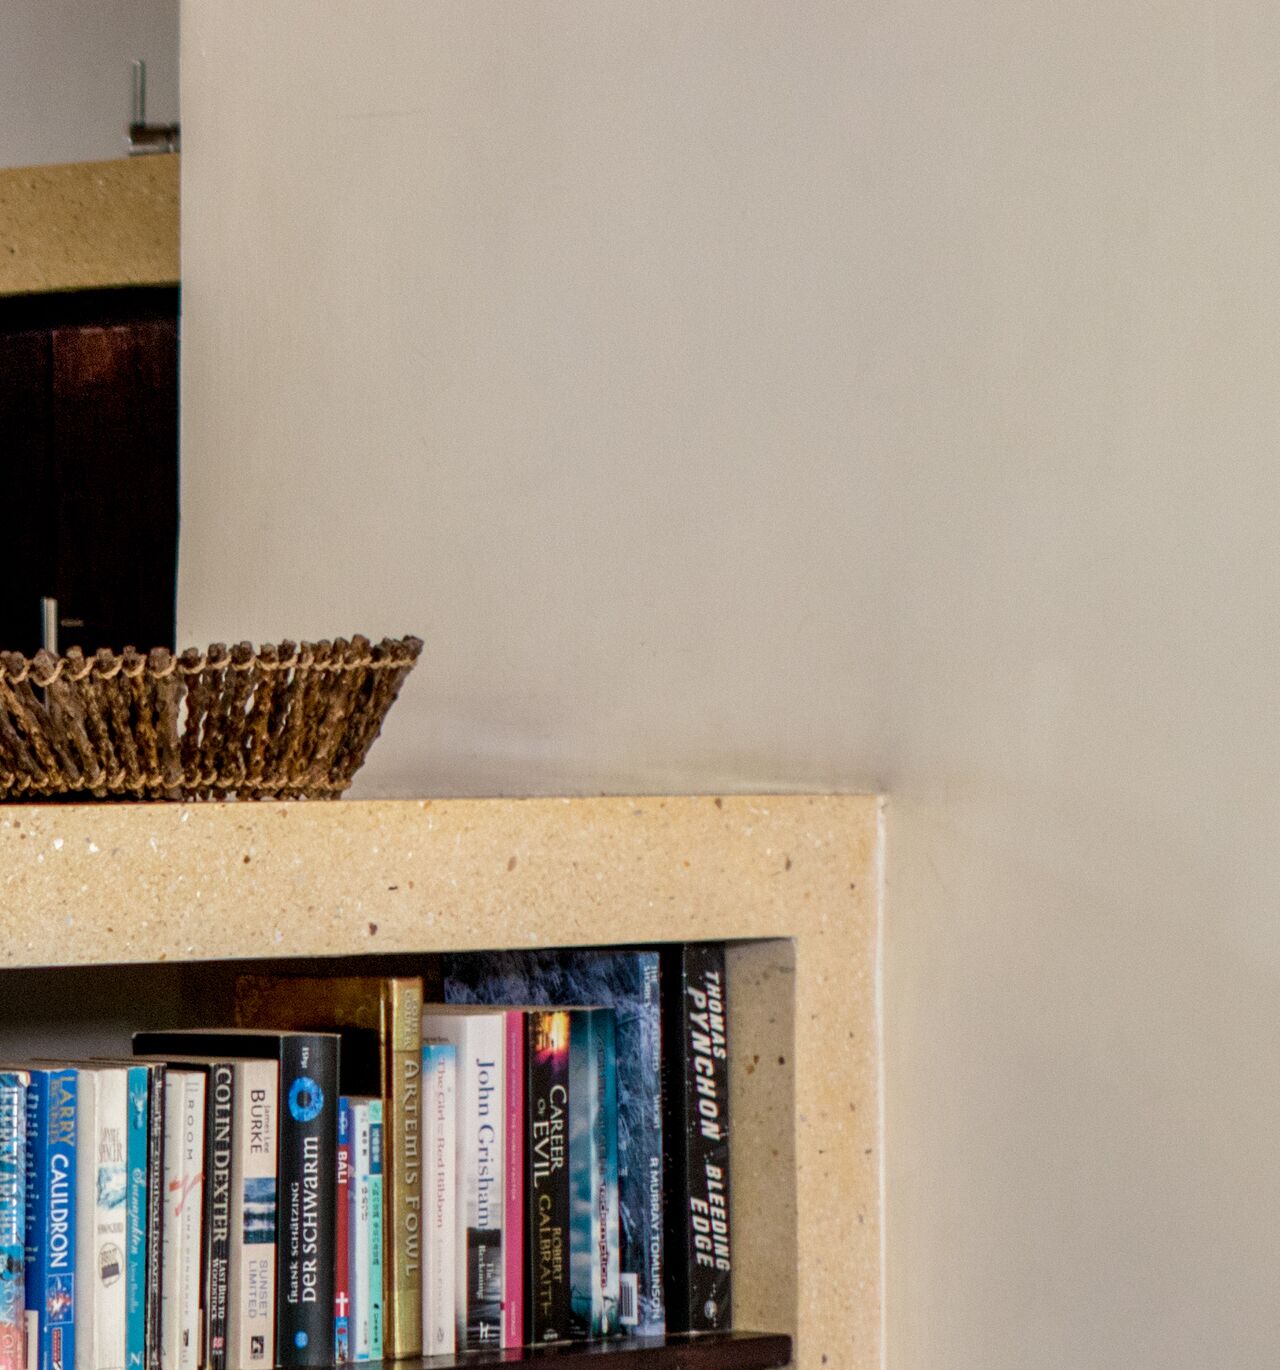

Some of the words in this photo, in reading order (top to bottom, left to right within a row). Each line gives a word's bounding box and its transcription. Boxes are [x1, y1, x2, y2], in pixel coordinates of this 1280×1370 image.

[705, 970, 727, 1060] THOMAS
[437, 1057, 446, 1089] The
[476, 1058, 496, 1117] John
[686, 985, 721, 1142] PYNCHON
[56, 1075, 76, 1147] LARRY
[187, 1099, 195, 1161] ROOM
[214, 1067, 232, 1143] COLIN
[250, 1089, 267, 1155] BURKE
[263, 1105, 273, 1135] James
[403, 1059, 420, 1184] ARTEMIS
[437, 1091, 446, 1121] Girl
[538, 1098, 547, 1115] OF
[549, 1084, 567, 1173] CAREER
[263, 1136, 272, 1153] Lee
[338, 1150, 349, 1184] BALI
[436, 1137, 445, 1168] Red
[533, 1120, 551, 1189] EVIL
[649, 1157, 660, 1169] R
[212, 1148, 230, 1243] DEXTER
[436, 1171, 446, 1229] Ribbon
[476, 1123, 496, 1230] Grisham
[649, 1170, 660, 1231] MURRAY
[50, 1153, 69, 1269] CAULDRON
[405, 1196, 420, 1277] FOWL
[597, 1185, 610, 1289] redemption
[689, 1196, 715, 1269] EDGE
[704, 1163, 731, 1272] BLEEDING
[218, 1258, 228, 1282] LAST
[475, 1244, 488, 1300] Reckoning
[487, 1263, 496, 1280] The
[538, 1193, 552, 1318] GALBRAITH
[551, 1226, 563, 1284] ROBERT
[650, 1234, 662, 1320] TOMLINSON
[210, 1257, 220, 1322] WOODSTOCK
[217, 1305, 226, 1320] TO
[218, 1284, 227, 1303] BUS
[248, 1259, 258, 1319] LIMITED
[258, 1259, 269, 1320] SUNSET
